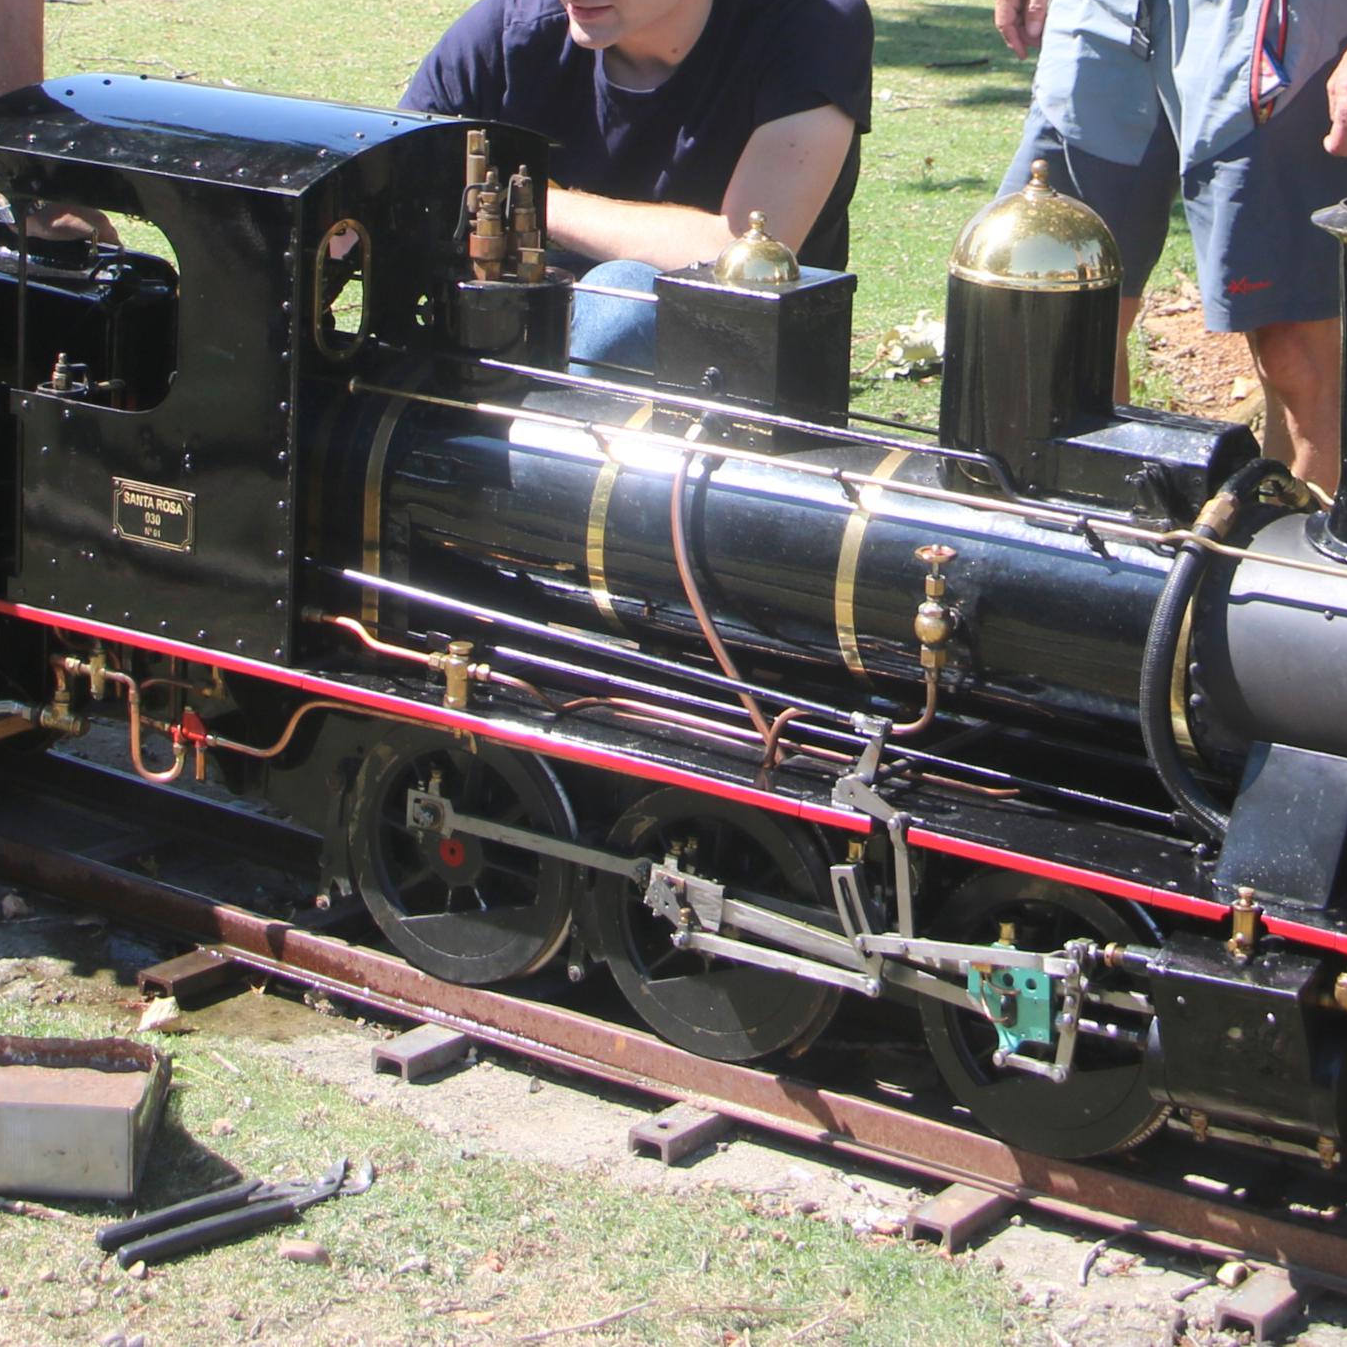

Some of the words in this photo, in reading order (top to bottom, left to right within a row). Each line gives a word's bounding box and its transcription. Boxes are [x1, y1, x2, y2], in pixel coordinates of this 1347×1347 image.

[124, 491, 155, 509] SANTA
[156, 498, 184, 516] ROSA
[145, 512, 162, 526] 030
[153, 529, 161, 539] 01
